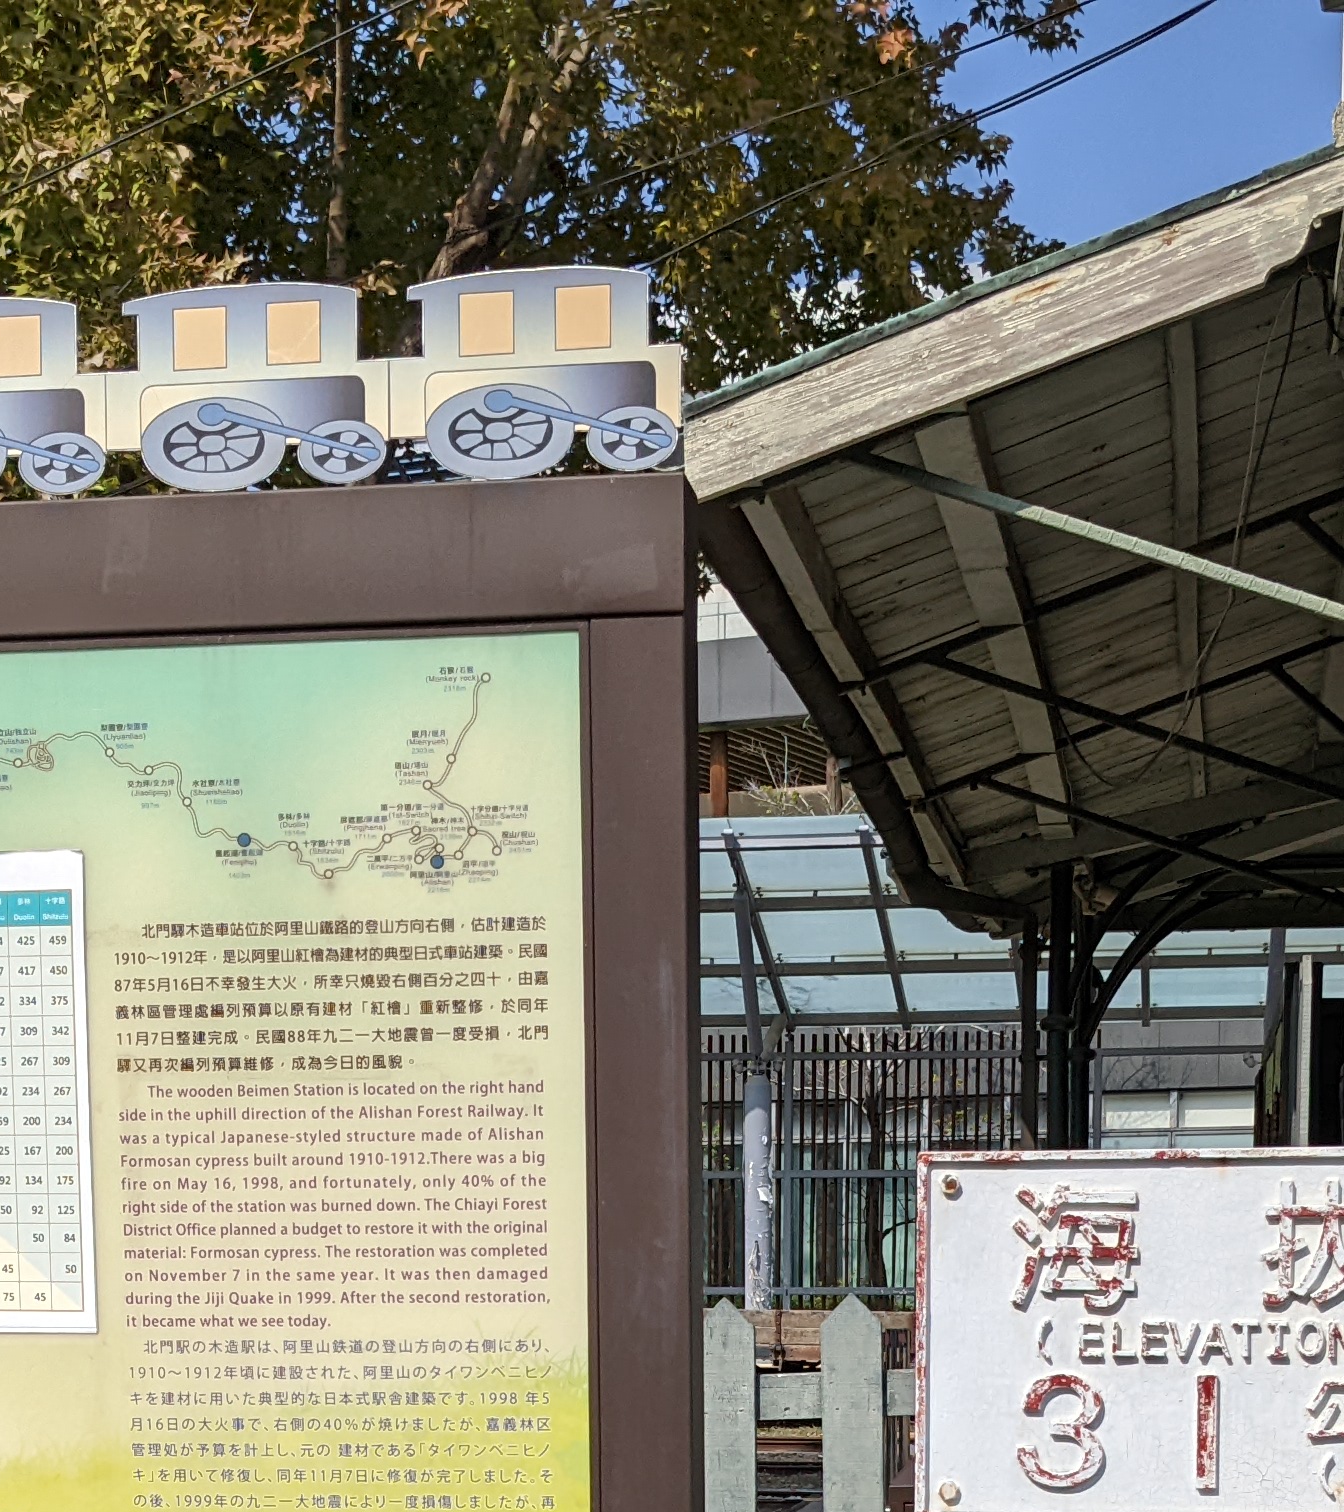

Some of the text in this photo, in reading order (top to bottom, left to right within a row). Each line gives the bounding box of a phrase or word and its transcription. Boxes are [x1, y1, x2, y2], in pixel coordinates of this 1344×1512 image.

[147, 1080, 543, 1098] The wooden Beimen Station is located on the right hand
[119, 1104, 543, 1123] side in the uphill direction of the Alishan Forest Railway. It
[120, 1127, 543, 1147] was a typical Japanese-styled structure made of Alishan
[121, 1150, 544, 1170] Formosan cypress built around 1910-1912.There was a big
[121, 1174, 546, 1193] fire on May 16, 1998, and fortunately, only 40% of the
[1016, 1374, 1218, 1492] 31
